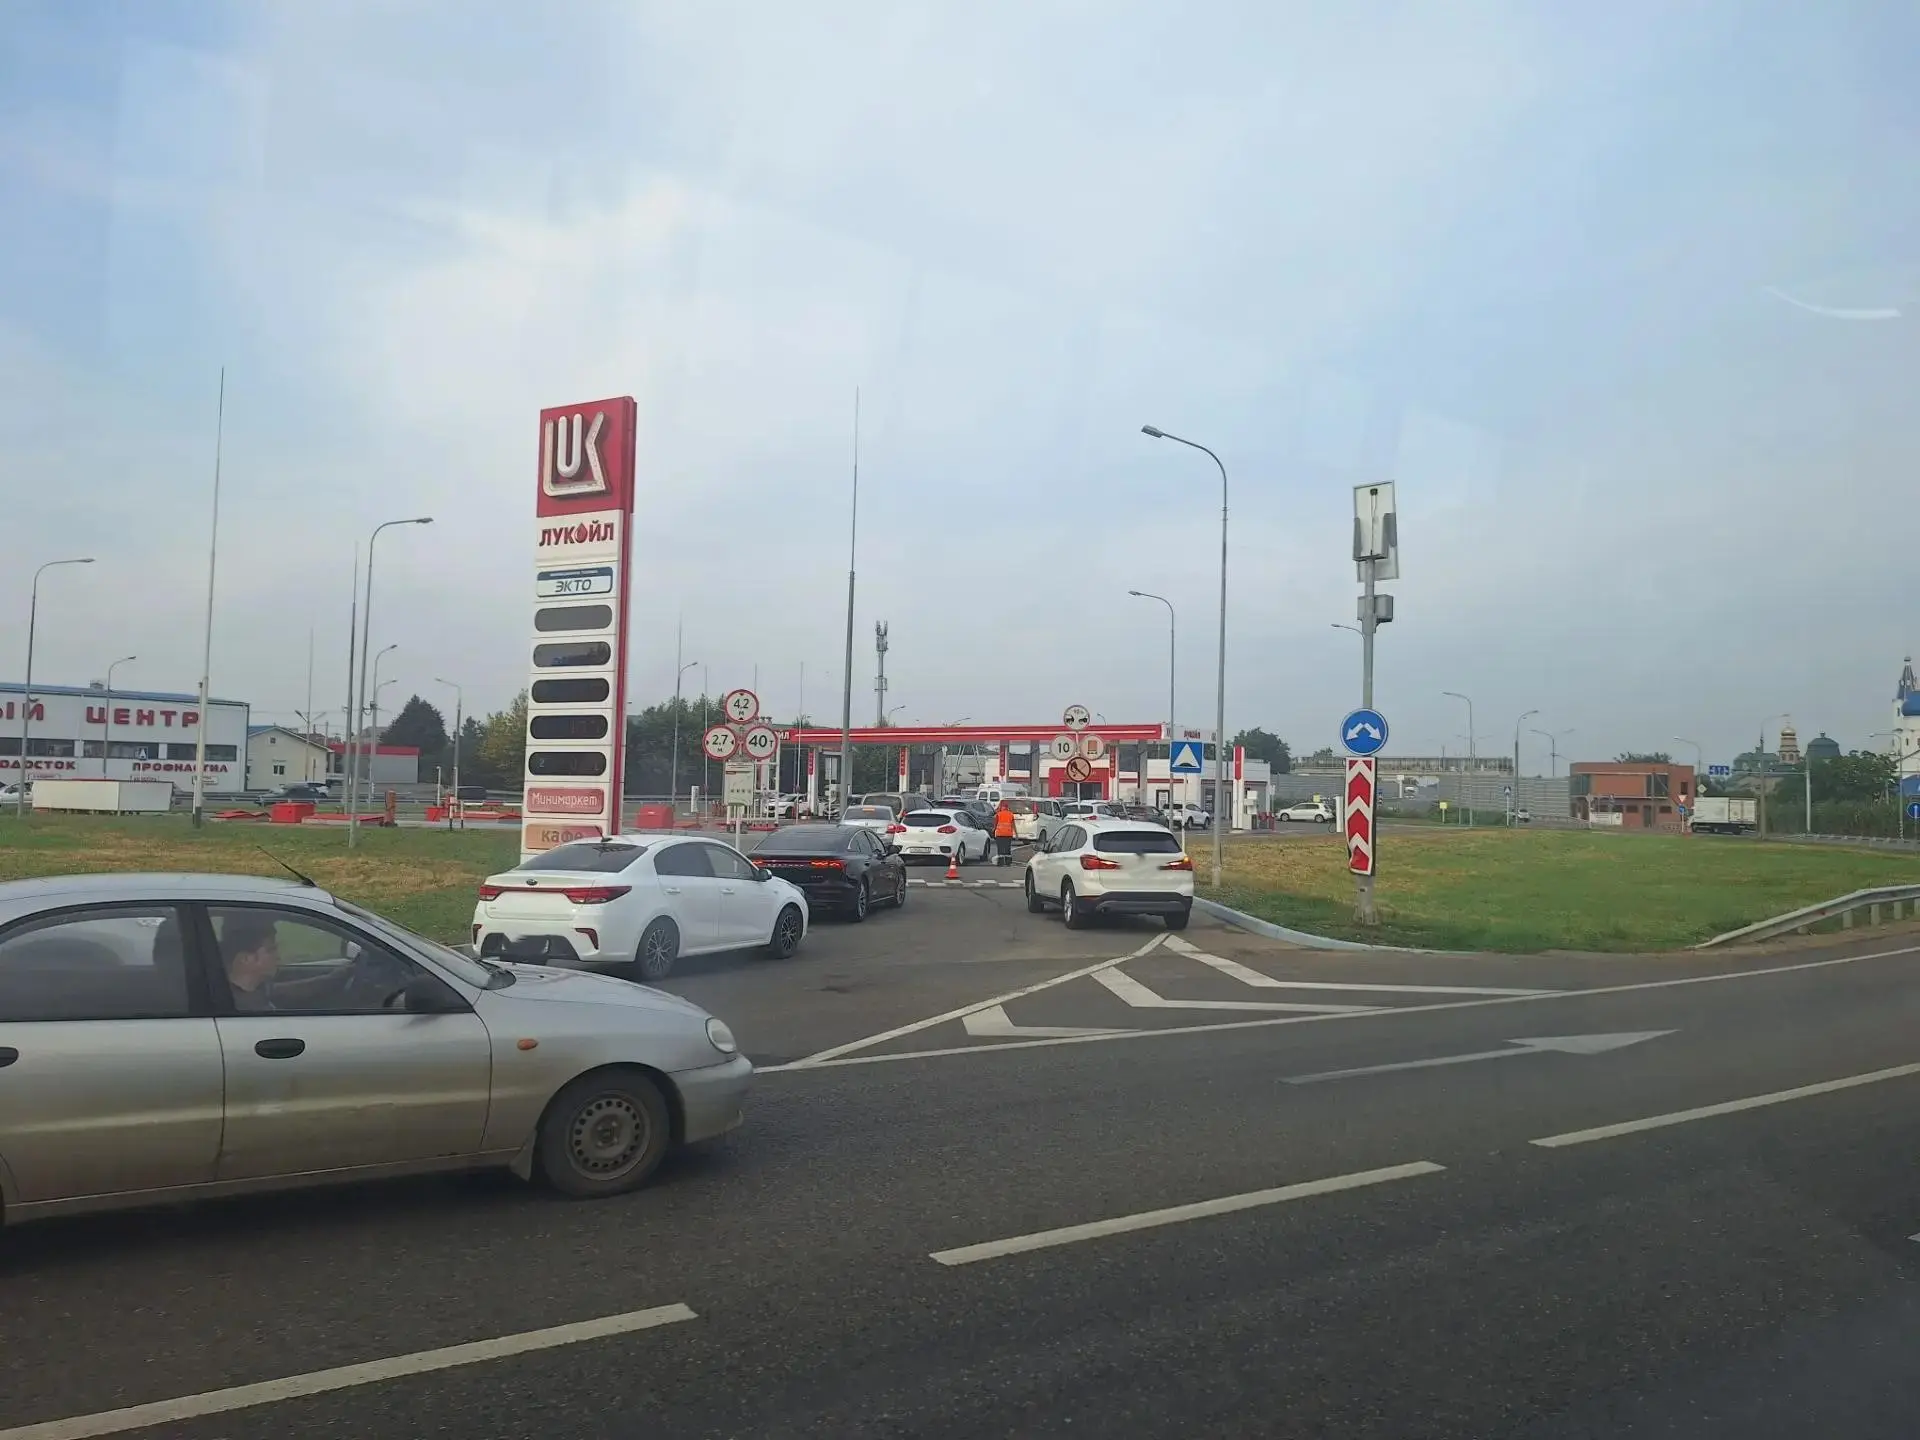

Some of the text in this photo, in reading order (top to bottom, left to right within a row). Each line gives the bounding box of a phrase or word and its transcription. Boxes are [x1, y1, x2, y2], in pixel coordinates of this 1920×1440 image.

[555, 579, 592, 593] ЭКТО
[86, 706, 199, 728] ЦЕНТР
[749, 735, 768, 748] 40
[1057, 742, 1070, 753] 10
[531, 792, 598, 808] Минимаркет
